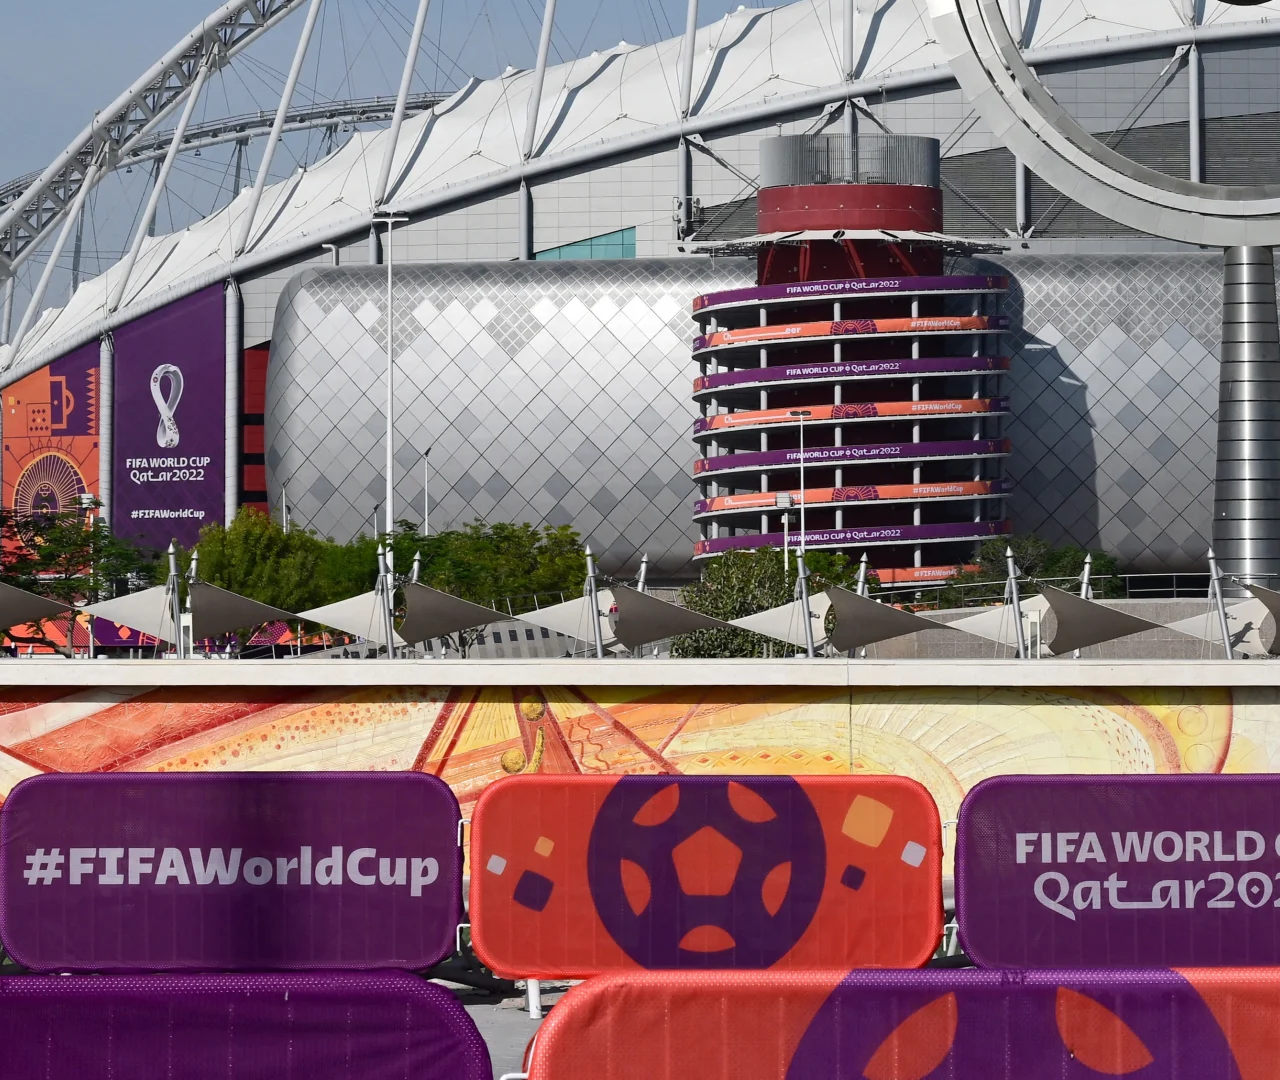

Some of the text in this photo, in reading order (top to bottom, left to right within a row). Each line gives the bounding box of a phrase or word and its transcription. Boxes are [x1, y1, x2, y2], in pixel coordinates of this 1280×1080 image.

[787, 286, 802, 294] FIFA
[802, 284, 828, 293] WORLD
[830, 282, 843, 291] CUP
[786, 368, 801, 376] FIFA
[802, 366, 828, 374] WORLD
[829, 365, 844, 373] CUP
[911, 403, 962, 411] #FIFAWorldCup
[802, 450, 828, 458] WORLD
[830, 449, 844, 457] CUP
[126, 456, 210, 469] FIFA WORLD CUP
[130, 470, 205, 485] Qatar2022
[912, 486, 963, 494] #FIFAWorldCup
[131, 508, 205, 520] #FIFAWorldCup
[830, 531, 845, 539] CUP
[1016, 832, 1107, 864] FIFA
[1111, 831, 1266, 862] WORLD
[23, 846, 439, 896] #FIFAWorldCup
